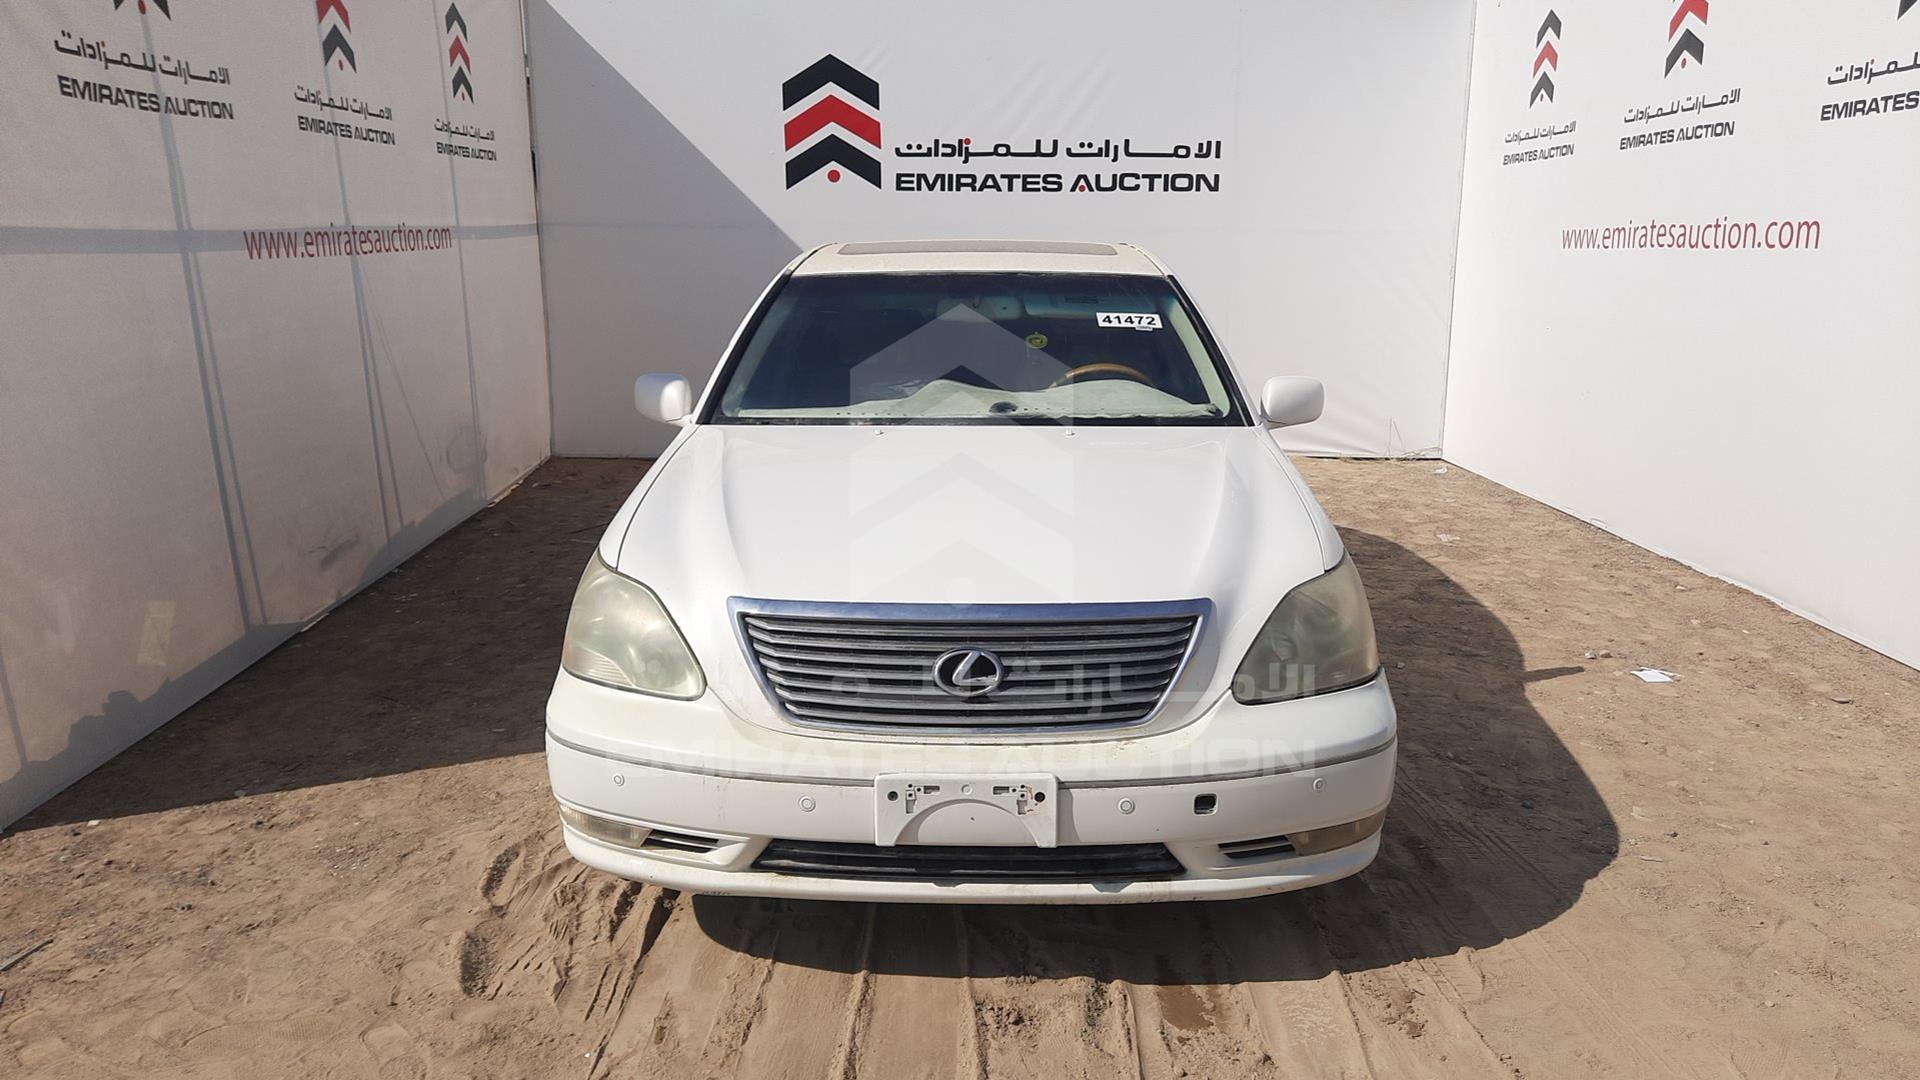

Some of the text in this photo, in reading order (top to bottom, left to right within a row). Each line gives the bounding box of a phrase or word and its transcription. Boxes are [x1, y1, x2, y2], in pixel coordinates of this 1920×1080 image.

[57, 74, 234, 120] EMIRATES AUCTION
[1820, 90, 1920, 122] EMIRATES
[297, 115, 396, 146] EMIRATES AUCTION
[1620, 121, 1736, 150] EMIRATES AUCTION
[436, 142, 497, 161] EMIRATES AUCTION
[1503, 144, 1575, 166] EMIRATES AUCTION
[895, 172, 1221, 193] EMIRATES AUCTION
[243, 222, 453, 260] www.emiratesauction.com
[1562, 216, 1821, 250] www.emiratesauction.com
[1102, 314, 1157, 326] 41472
